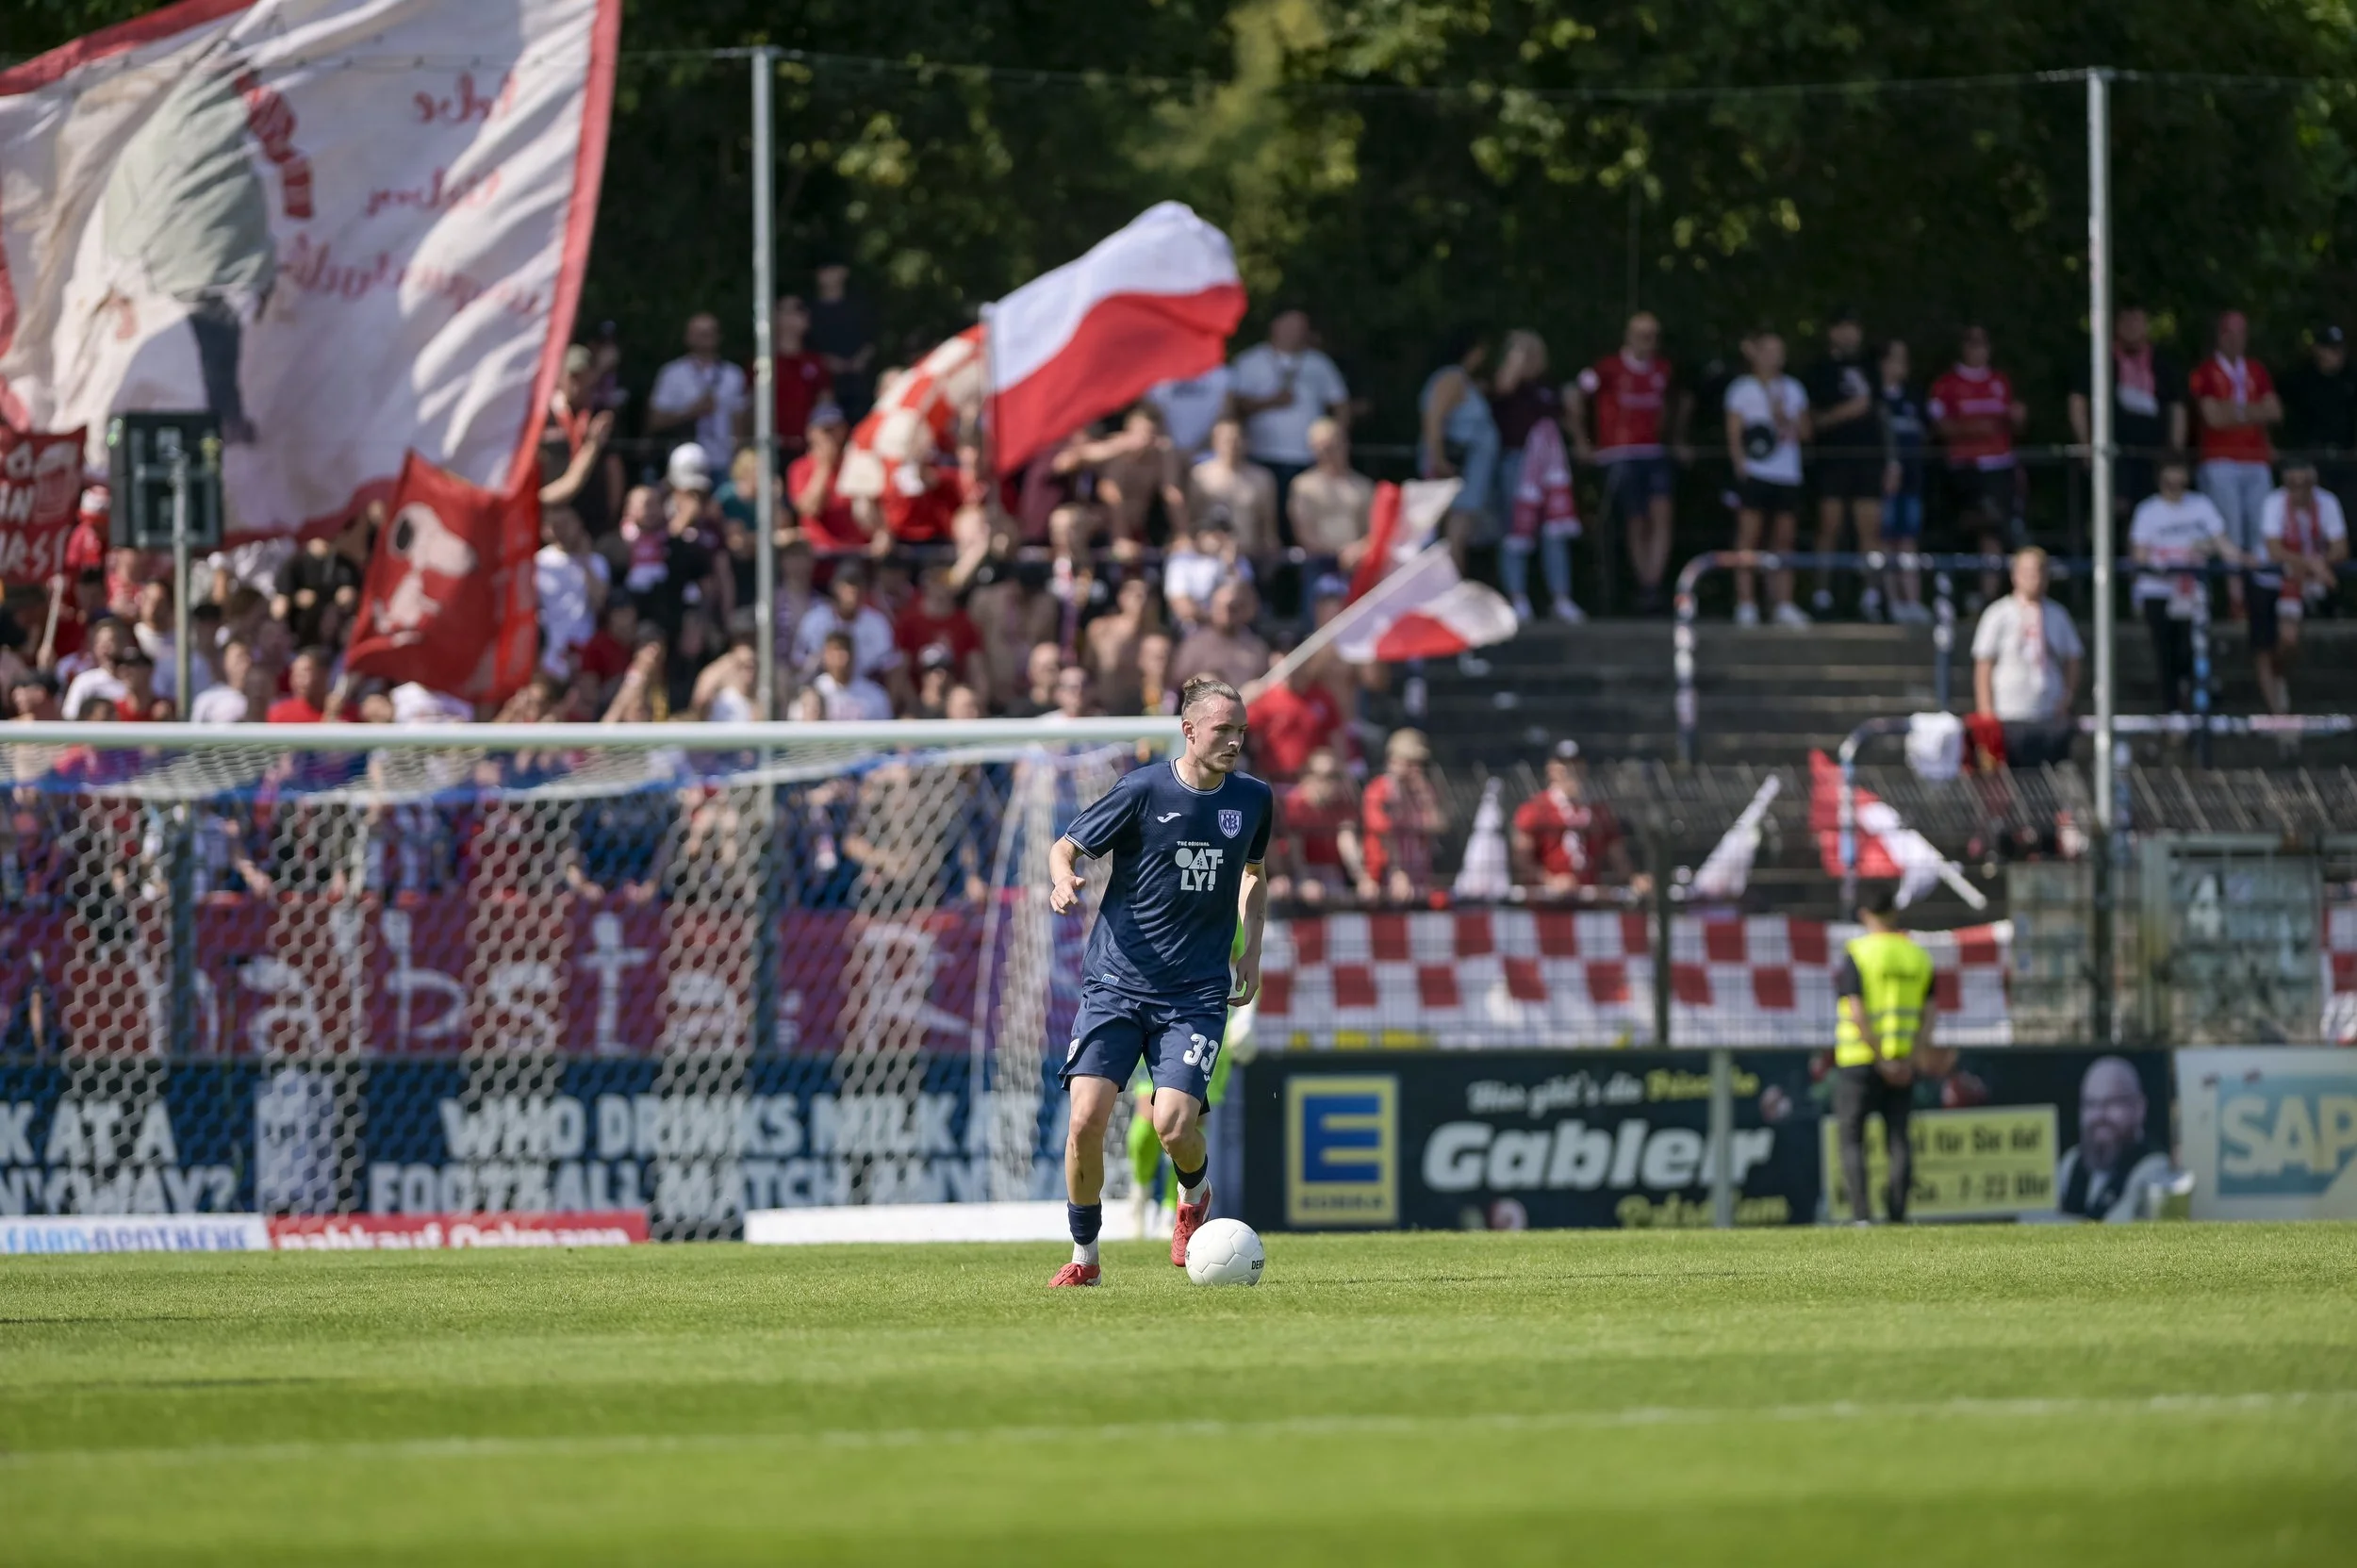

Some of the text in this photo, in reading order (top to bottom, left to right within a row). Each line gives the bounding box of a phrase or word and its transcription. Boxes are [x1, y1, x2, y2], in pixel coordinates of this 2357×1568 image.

[1180, 869, 1216, 891] LY!
[1183, 1033, 1219, 1074] 33
[135, 1098, 178, 1165] A
[439, 1094, 587, 1160] WHO
[596, 1092, 800, 1159] DRINKS
[810, 1091, 958, 1156] MILK
[1303, 1093, 1382, 1183] E
[1422, 1118, 1775, 1191] Gabler
[2222, 1096, 2357, 1176] SAP
[368, 1160, 648, 1213] FOOTBALL
[659, 1158, 852, 1220] MATCH
